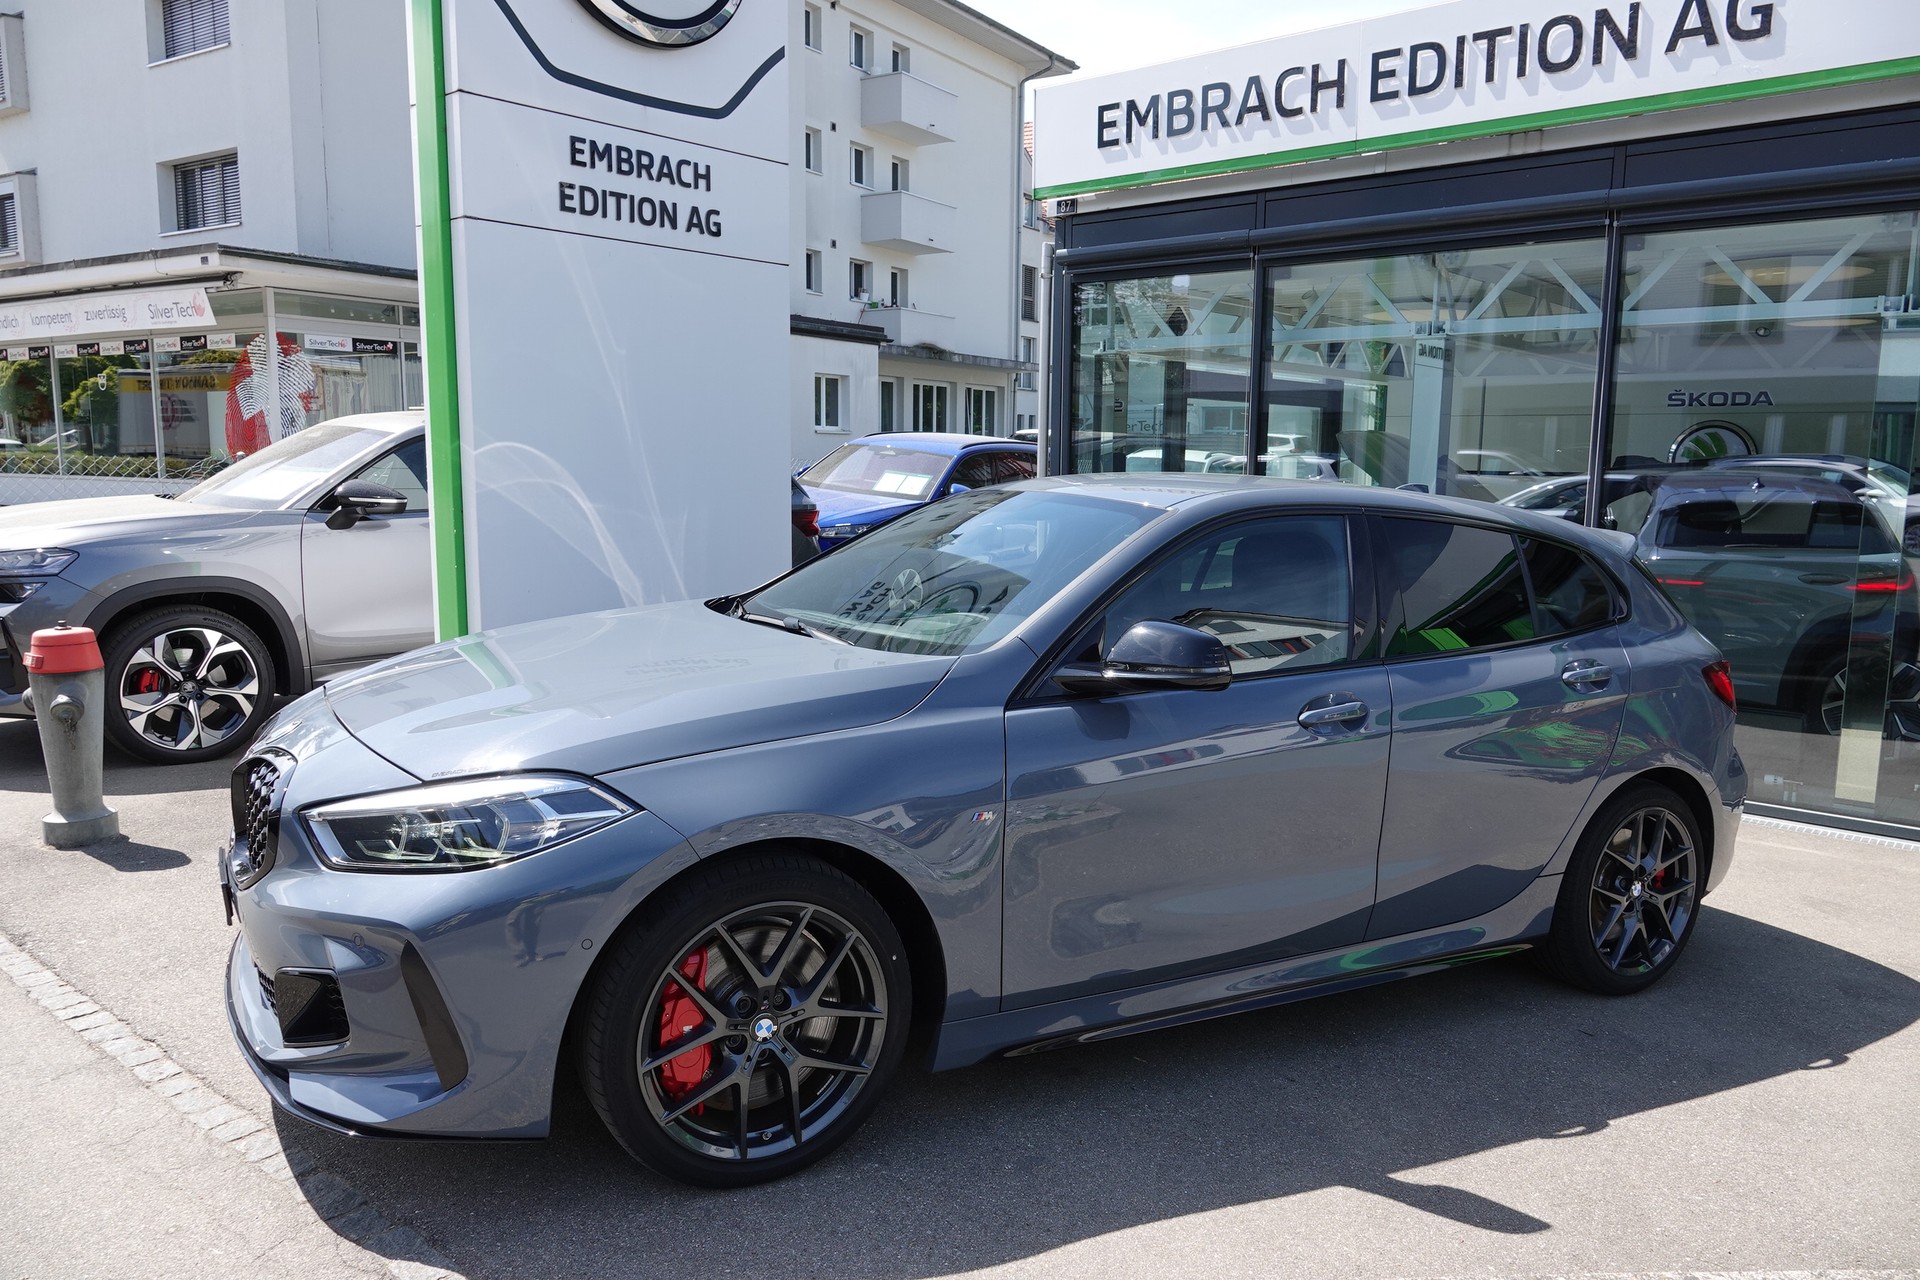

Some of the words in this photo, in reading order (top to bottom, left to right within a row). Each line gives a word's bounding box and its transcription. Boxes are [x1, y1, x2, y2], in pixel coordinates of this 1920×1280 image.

[1097, 58, 1346, 149] EMBRACH
[1370, 2, 1642, 103] EDITION
[1665, 0, 1775, 55] AG
[569, 135, 711, 192] EMBRACH
[559, 181, 678, 231] EDITION
[685, 206, 722, 238] AG
[1060, 200, 1072, 213] 87
[29, 312, 73, 329] kompetent
[84, 304, 127, 323] zuverlässig
[1667, 389, 1775, 407] ŠKODA
